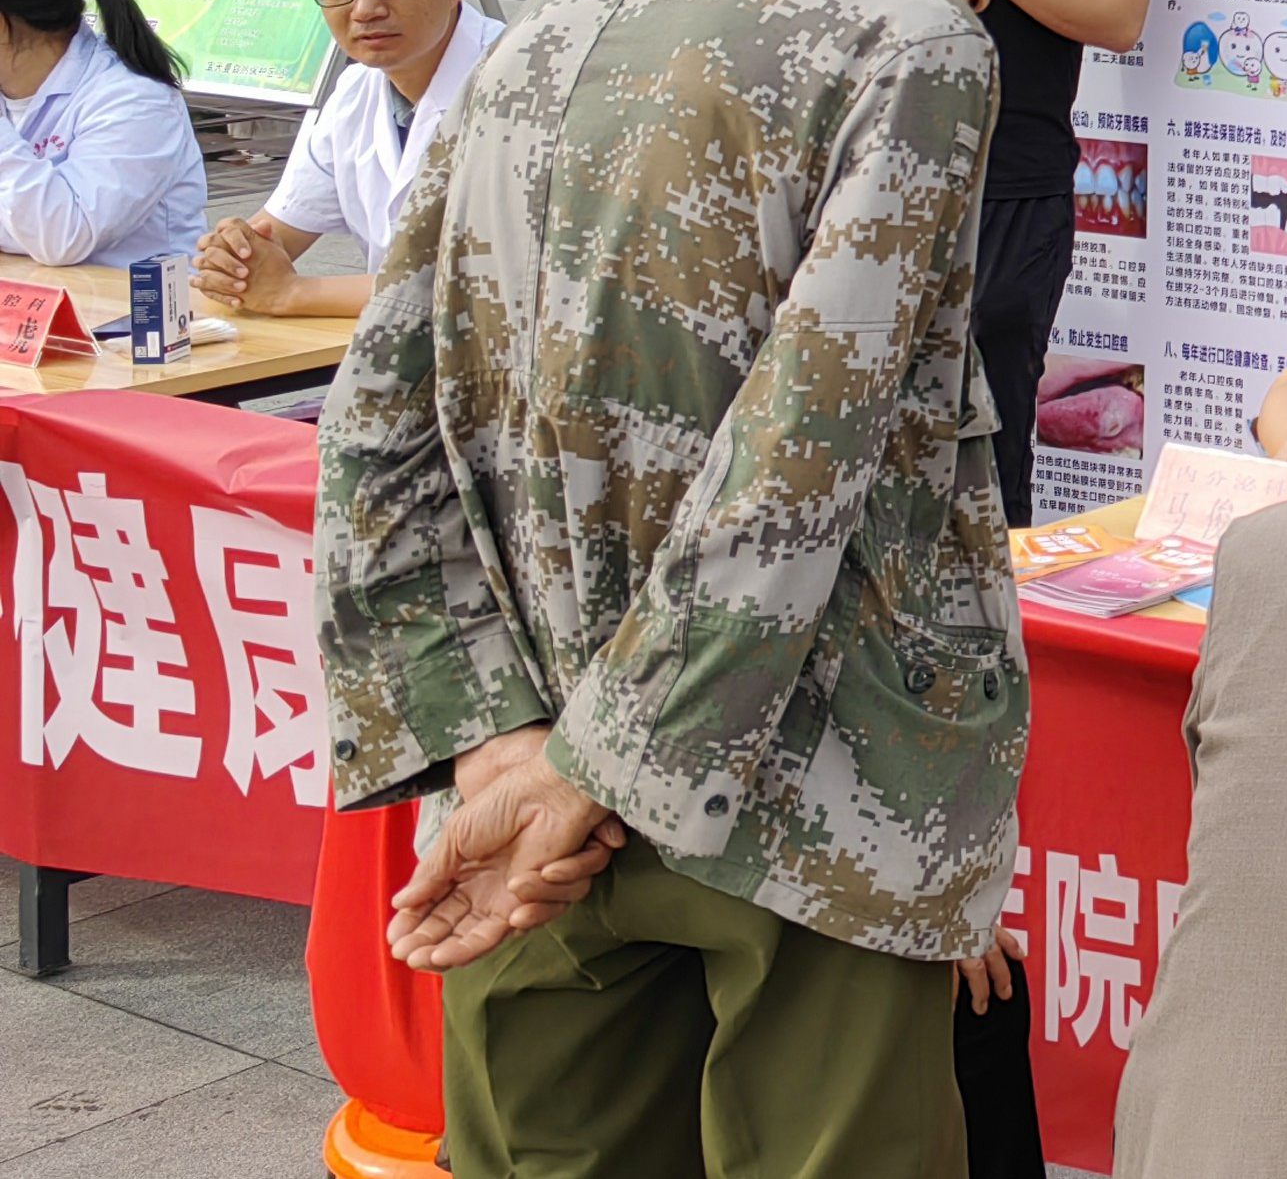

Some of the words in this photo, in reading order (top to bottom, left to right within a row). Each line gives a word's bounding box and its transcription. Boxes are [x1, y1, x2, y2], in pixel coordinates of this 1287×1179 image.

[1049, 327, 1129, 352] 化，防止发生口腔癌
